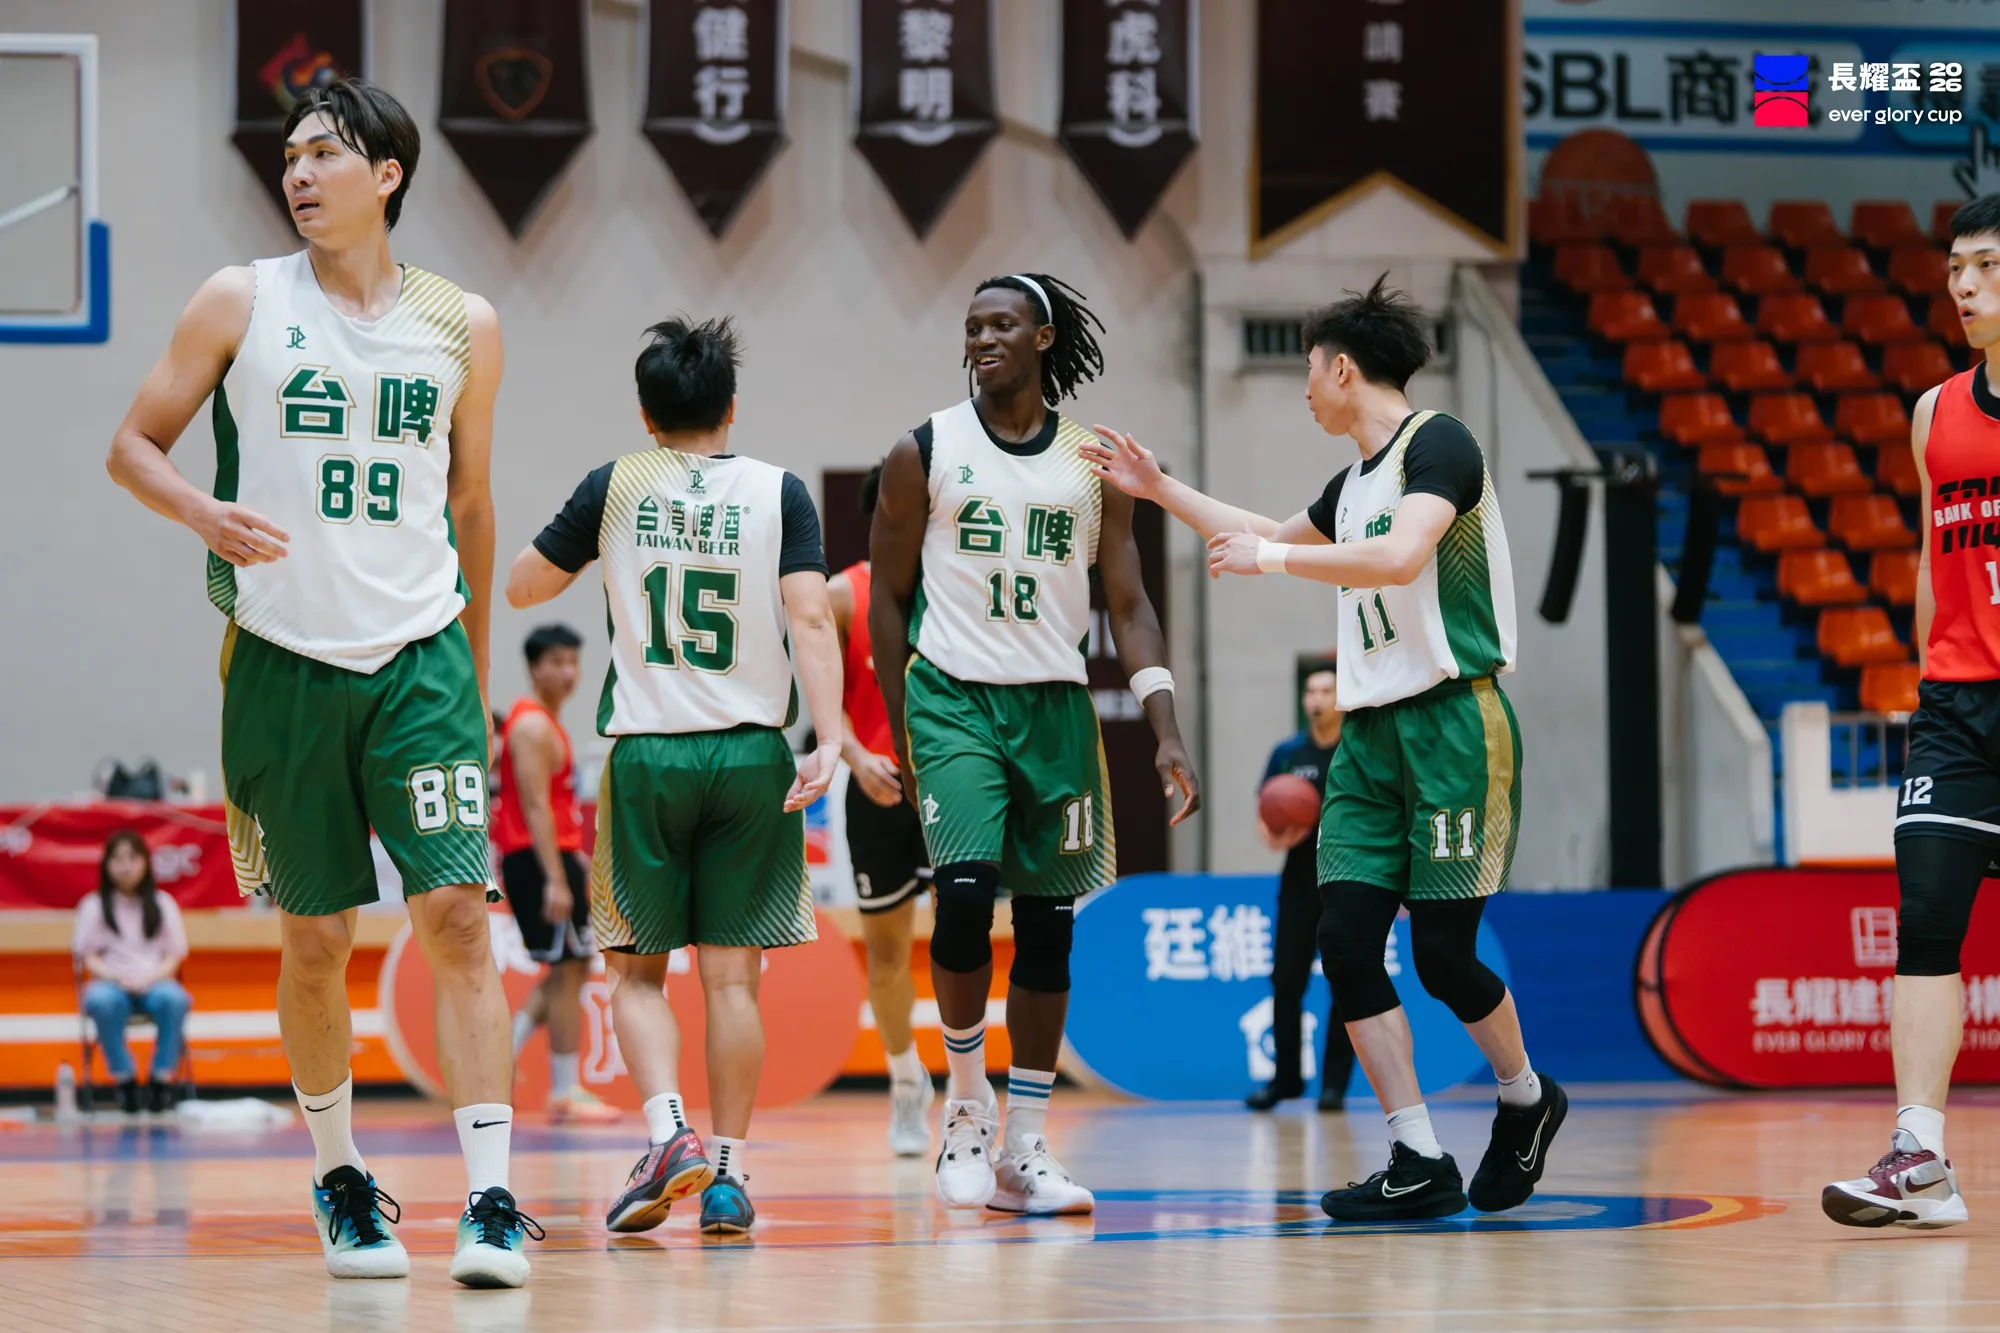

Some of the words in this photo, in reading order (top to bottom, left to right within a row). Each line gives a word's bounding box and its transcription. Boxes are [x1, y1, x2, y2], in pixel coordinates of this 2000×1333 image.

[1523, 50, 1823, 126] BL商
[277, 363, 444, 449] 台啤
[316, 453, 405, 527] 89
[1933, 502, 1973, 528] BANK
[635, 532, 693, 552] TAIWAN
[698, 539, 740, 556] BEER
[953, 495, 1079, 567] 台啤
[640, 561, 741, 675] 15
[985, 568, 1042, 625] 18
[1356, 588, 1399, 657] 11
[405, 760, 488, 836] 89
[1059, 791, 1094, 855] 18
[1901, 776, 1934, 807] 12
[1430, 807, 1477, 862] 11
[1753, 1030, 1802, 1053] EVER
[1803, 1029, 1867, 1053] GLORY
